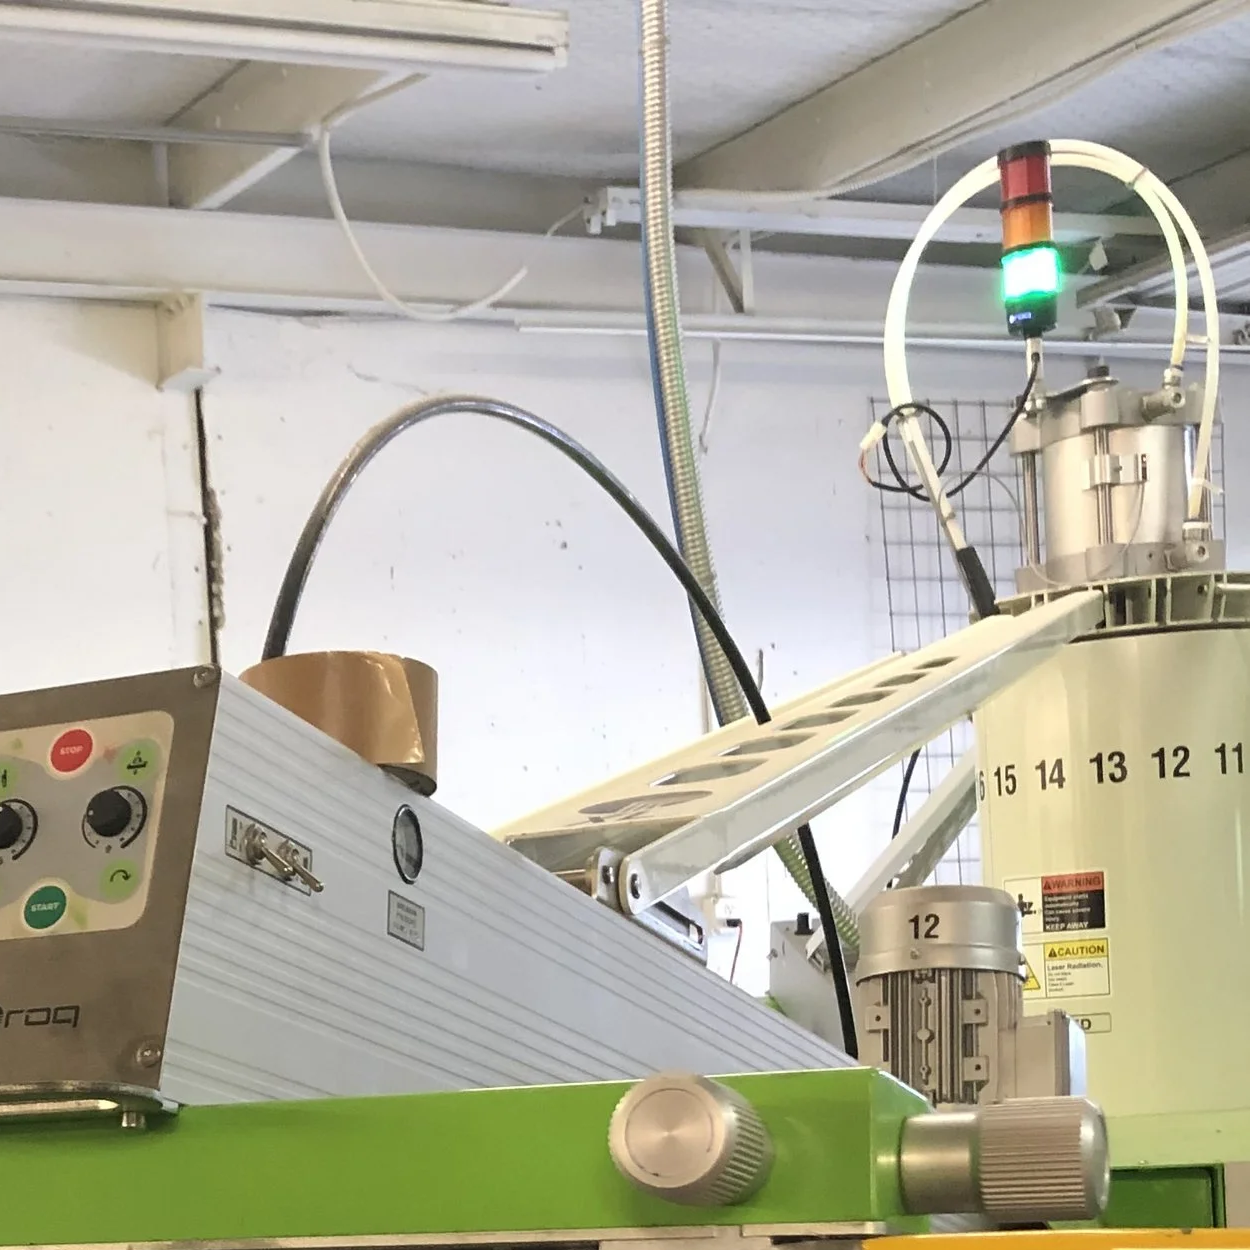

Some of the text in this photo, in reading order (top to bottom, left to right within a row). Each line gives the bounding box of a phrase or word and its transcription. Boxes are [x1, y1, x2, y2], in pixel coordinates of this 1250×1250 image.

[60, 746, 84, 756] STOP
[994, 764, 1017, 797] 15
[1035, 758, 1066, 791] 14
[1089, 751, 1128, 784] 13
[1151, 745, 1191, 779] 12
[1214, 742, 1244, 775] 11
[1050, 876, 1101, 890] WARNING
[31, 902, 59, 912] START
[908, 913, 940, 939] 12
[1045, 921, 1089, 931] KEEP AWAY
[1058, 944, 1105, 958] CAUTION
